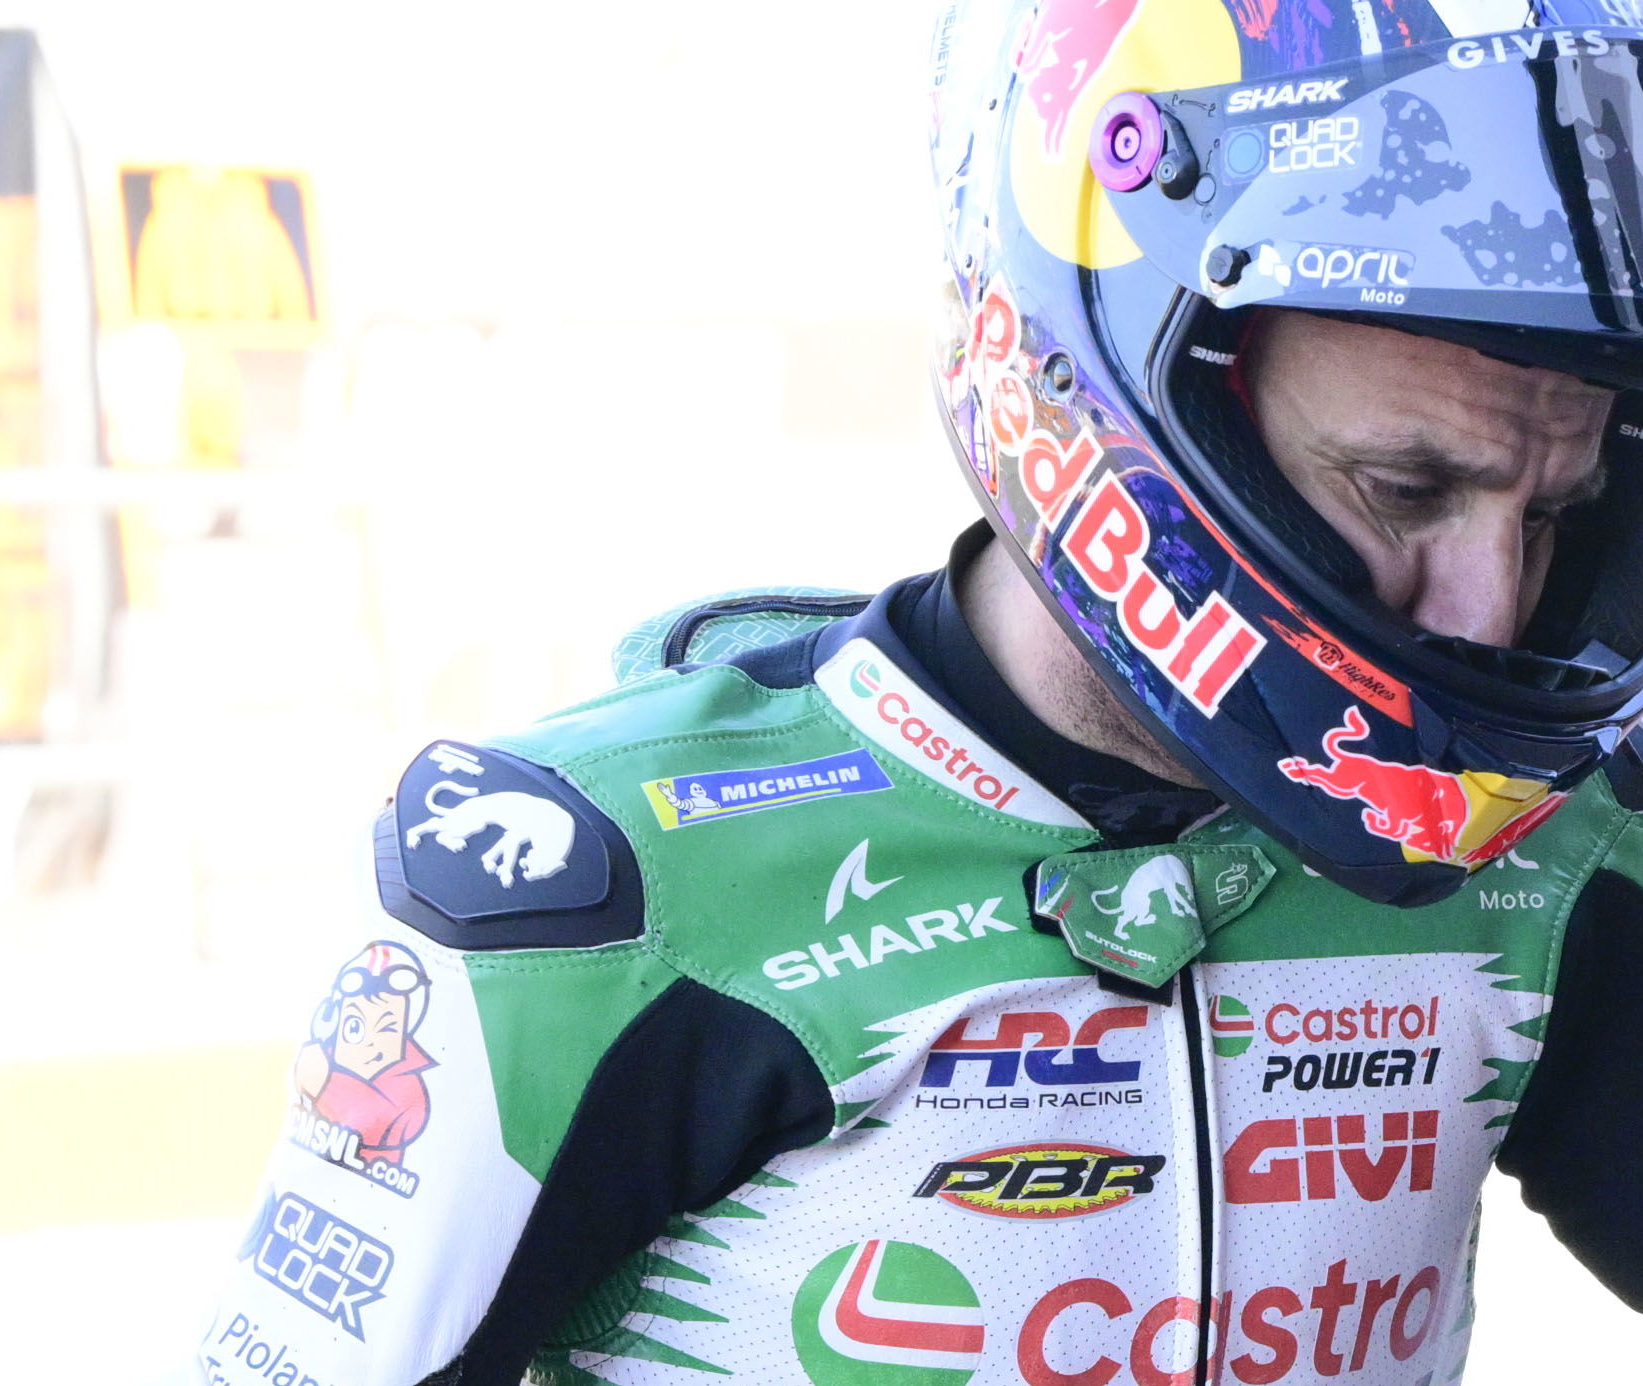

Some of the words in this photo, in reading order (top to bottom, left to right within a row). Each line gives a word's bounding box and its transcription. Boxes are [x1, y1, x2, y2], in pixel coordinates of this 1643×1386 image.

[1447, 29, 1613, 69] GIVES
[1227, 77, 1349, 112] SHARK
[1269, 117, 1359, 148] QUAD
[1269, 141, 1356, 173] LOCK
[1360, 287, 1406, 305] Moto
[968, 285, 1102, 526] Red
[1063, 475, 1262, 712] Bull
[875, 692, 1018, 810] Castrol
[721, 764, 861, 803] MICHELIN
[1479, 890, 1545, 910] Moto
[762, 895, 1018, 992] SHARK
[1263, 995, 1439, 1044] Castrol
[918, 1005, 1150, 1089] HRC
[1262, 1047, 1441, 1093] POWER1
[915, 1092, 1030, 1110] Honda
[1037, 1088, 1144, 1109] RACING
[910, 1153, 1167, 1199] PBR
[1222, 1109, 1440, 1205] GIVI
[274, 1198, 390, 1288] QUAD
[257, 1233, 375, 1329] LOCK
